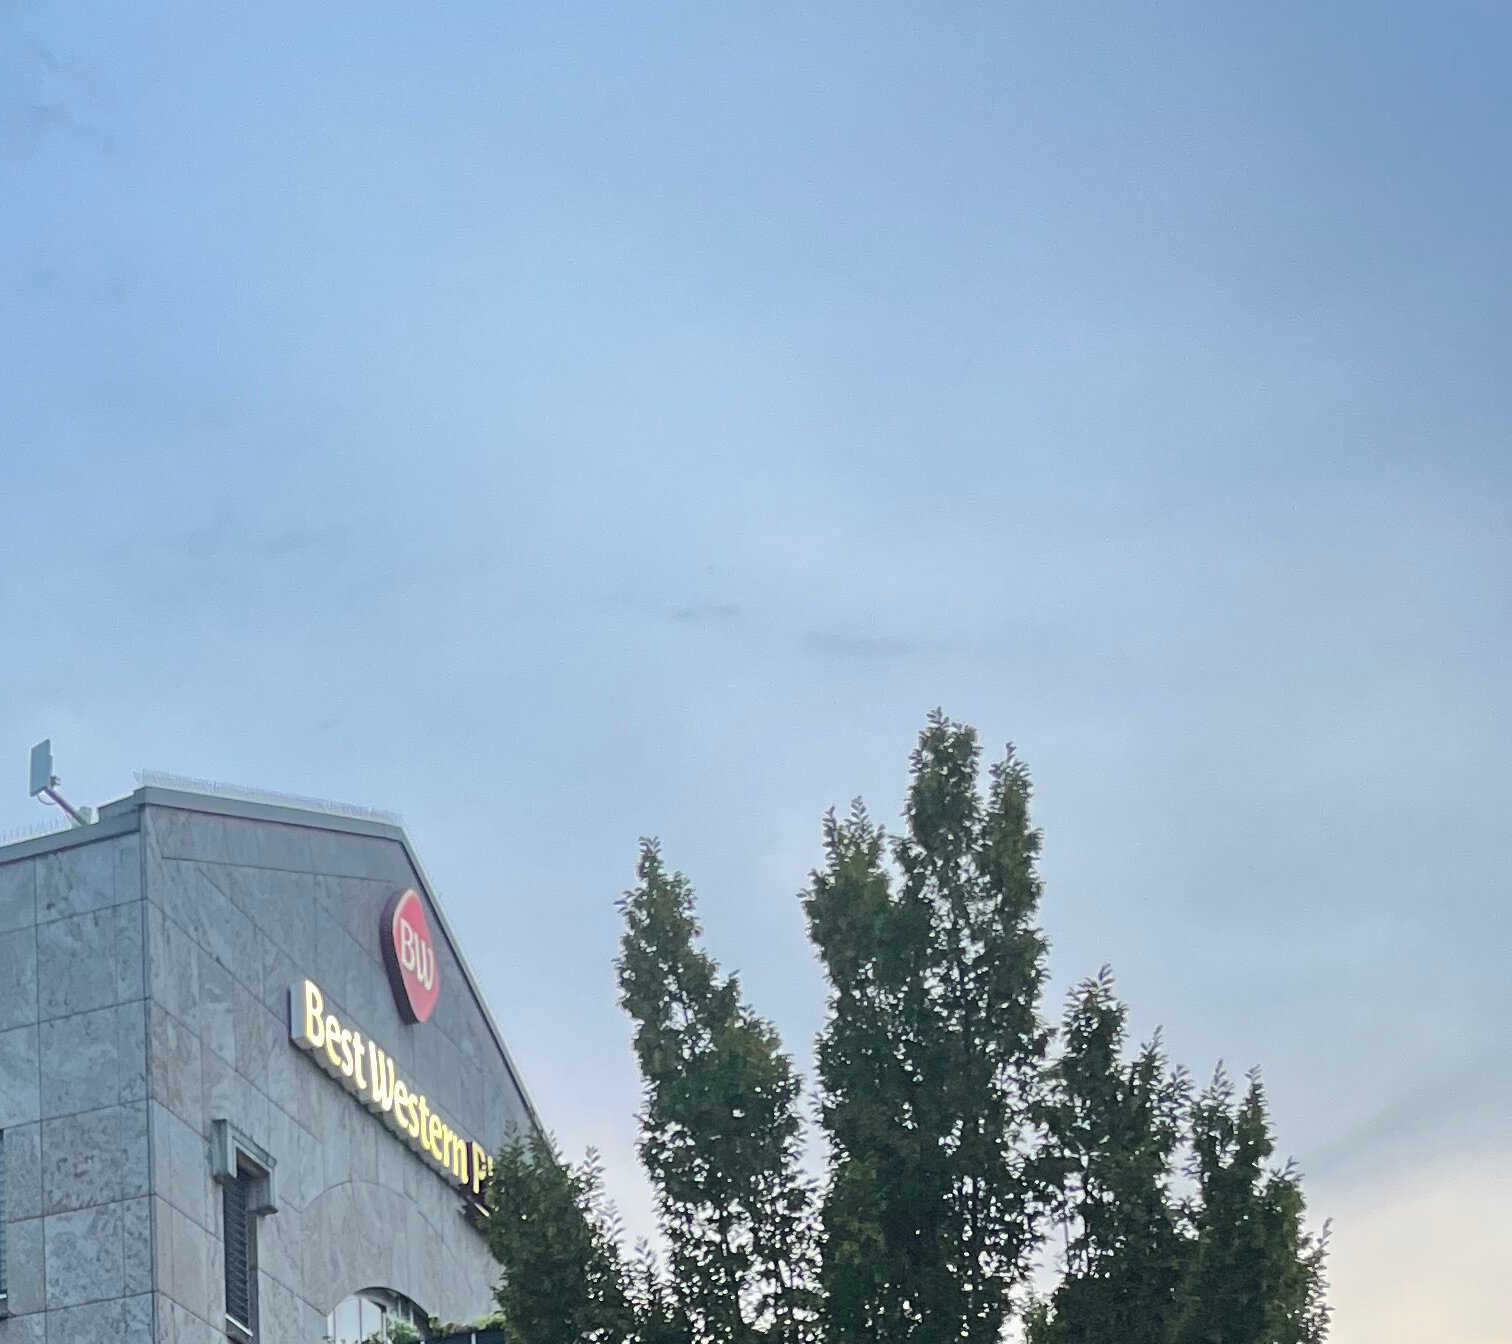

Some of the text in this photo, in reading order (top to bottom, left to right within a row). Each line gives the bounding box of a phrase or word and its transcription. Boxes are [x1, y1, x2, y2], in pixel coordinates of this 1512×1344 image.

[400, 917, 434, 991] BW
[305, 979, 367, 1090] Best
[368, 1040, 468, 1184] Western
